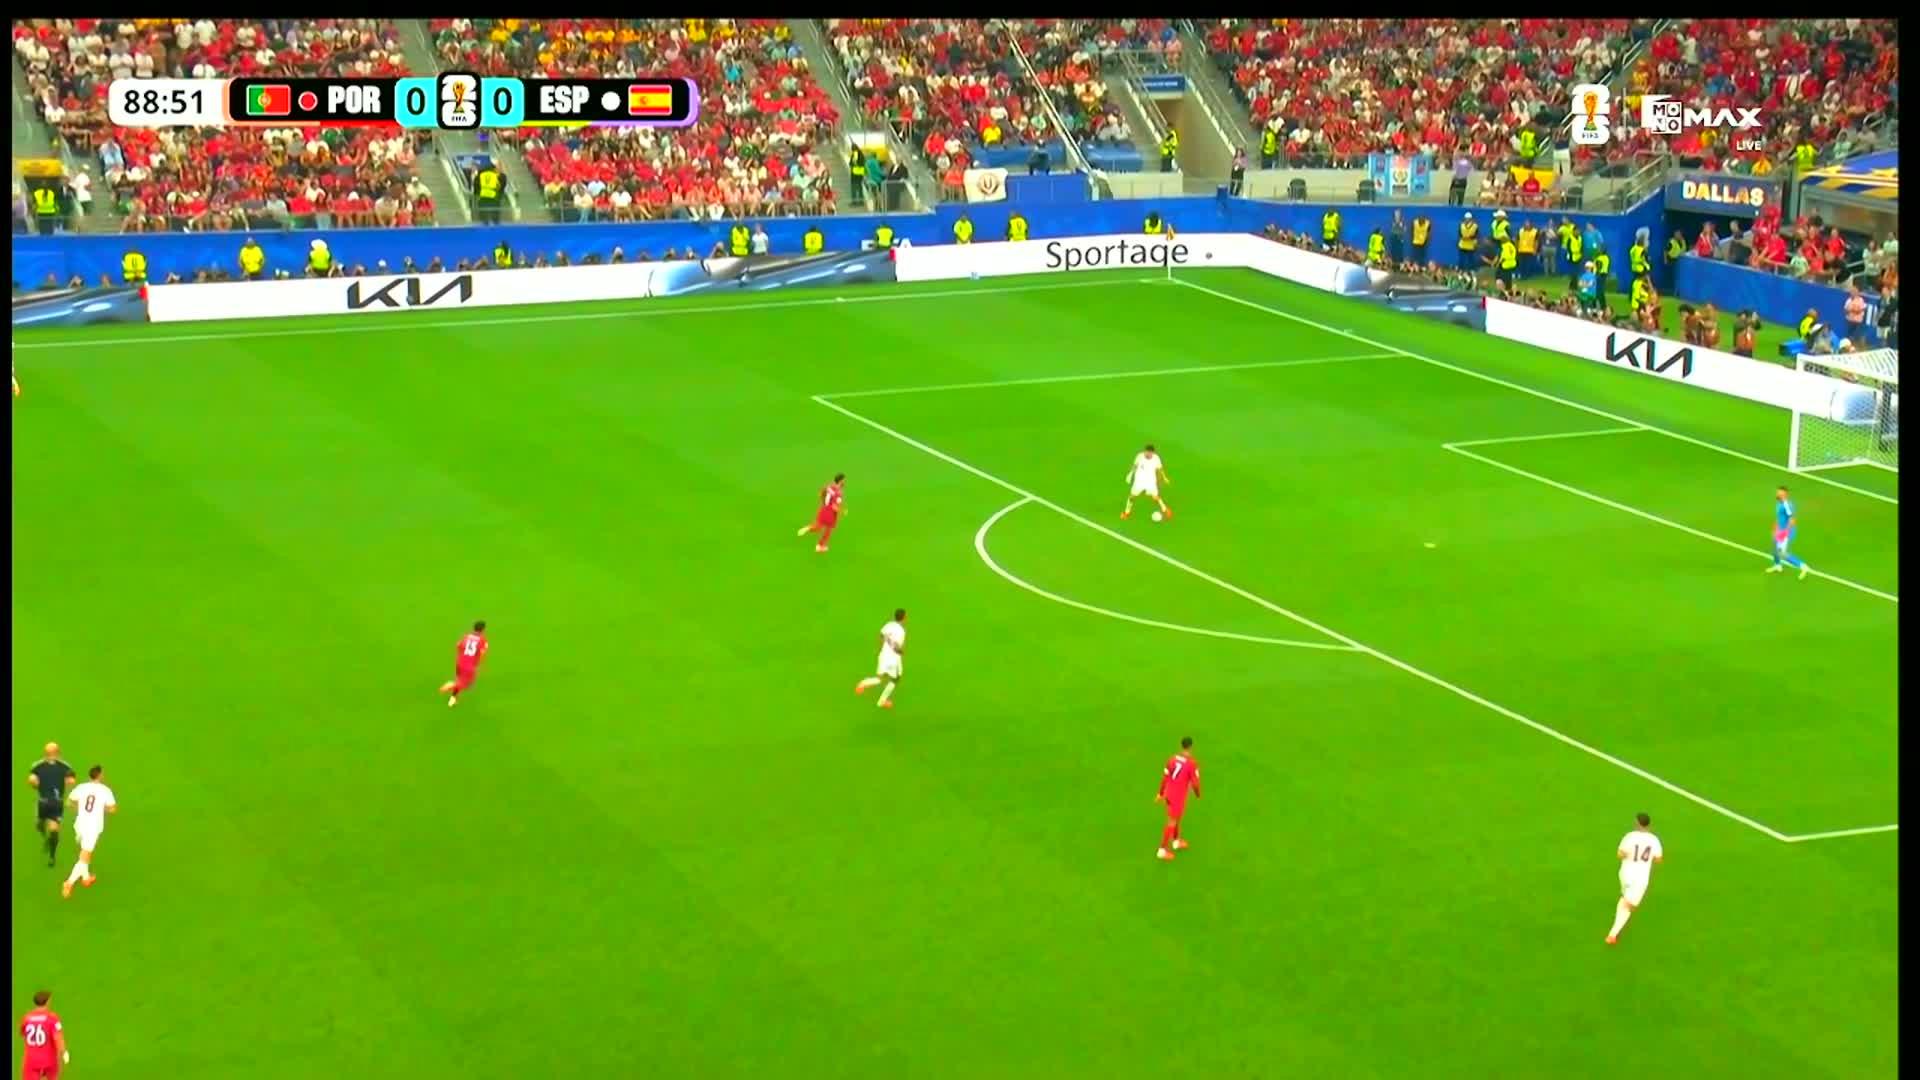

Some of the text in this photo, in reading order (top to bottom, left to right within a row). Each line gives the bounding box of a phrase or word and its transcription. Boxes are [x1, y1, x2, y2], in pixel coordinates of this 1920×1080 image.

[1682, 180, 1765, 207] DALLAS
[1046, 239, 1189, 271] Sportage
[347, 274, 473, 309] KIA
[1605, 332, 1693, 379] KIA
[1171, 761, 1183, 781] 7
[84, 793, 96, 813] 8
[1632, 843, 1652, 863] 14
[25, 1022, 47, 1048] 26
